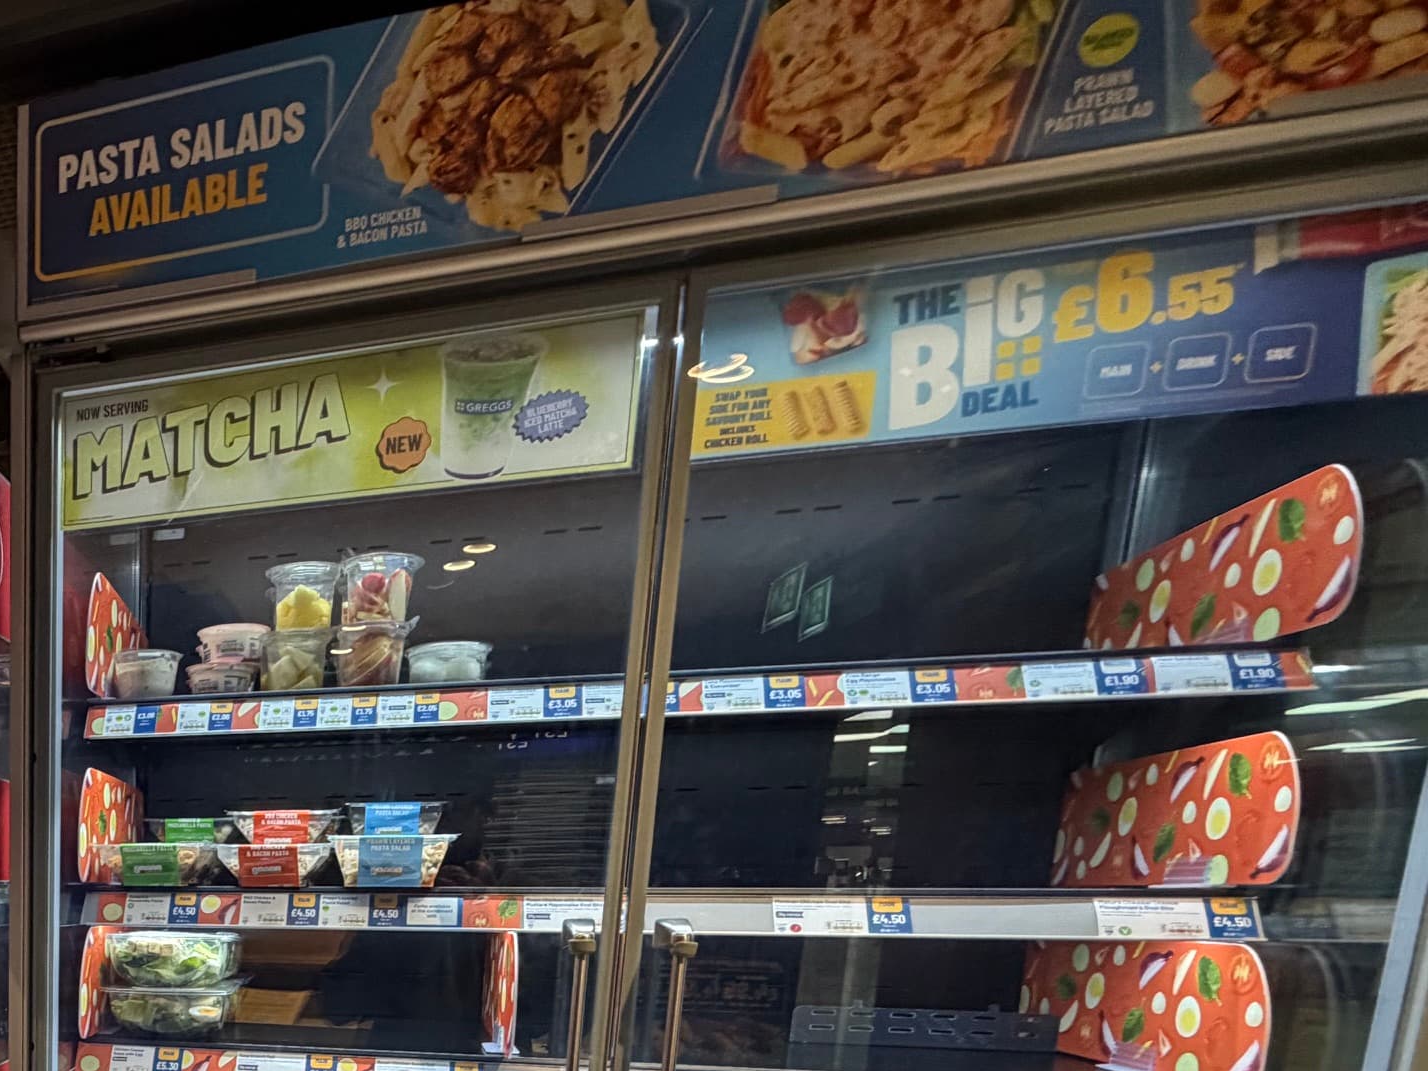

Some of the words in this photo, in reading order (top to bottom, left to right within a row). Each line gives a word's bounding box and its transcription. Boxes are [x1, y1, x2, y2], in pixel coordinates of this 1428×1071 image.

[58, 135, 161, 194] PASTA
[170, 101, 307, 170] SALADS
[88, 163, 269, 237] AVAILABLE
[344, 216, 370, 232] BBQ
[371, 206, 422, 227] CHICKEN
[337, 236, 347, 248] &
[349, 227, 388, 247] BACON
[390, 220, 428, 240] PASTA
[1053, 250, 1237, 343] £6.55
[894, 282, 963, 326] THE
[887, 268, 1046, 431] BIG
[961, 380, 1040, 418] DEAL
[76, 406, 100, 422] NOW
[103, 399, 149, 418] SERVING
[465, 400, 513, 413] GREGGS
[538, 420, 565, 433] LATTE
[72, 372, 351, 500] MATCHA
[704, 436, 743, 448] CHICKEN
[385, 434, 422, 455] NEW
[1105, 674, 1139, 685] £1.90
[1240, 668, 1274, 679] £1.90
[769, 689, 802, 699] £3.05
[916, 683, 951, 694] £3.05
[173, 907, 195, 916] £4.50
[291, 908, 316, 917] £4.50
[373, 909, 398, 919] £4.50
[873, 914, 906, 924] £4.50
[1213, 917, 1252, 927] £4.50
[156, 1062, 179, 1071] £5.30
